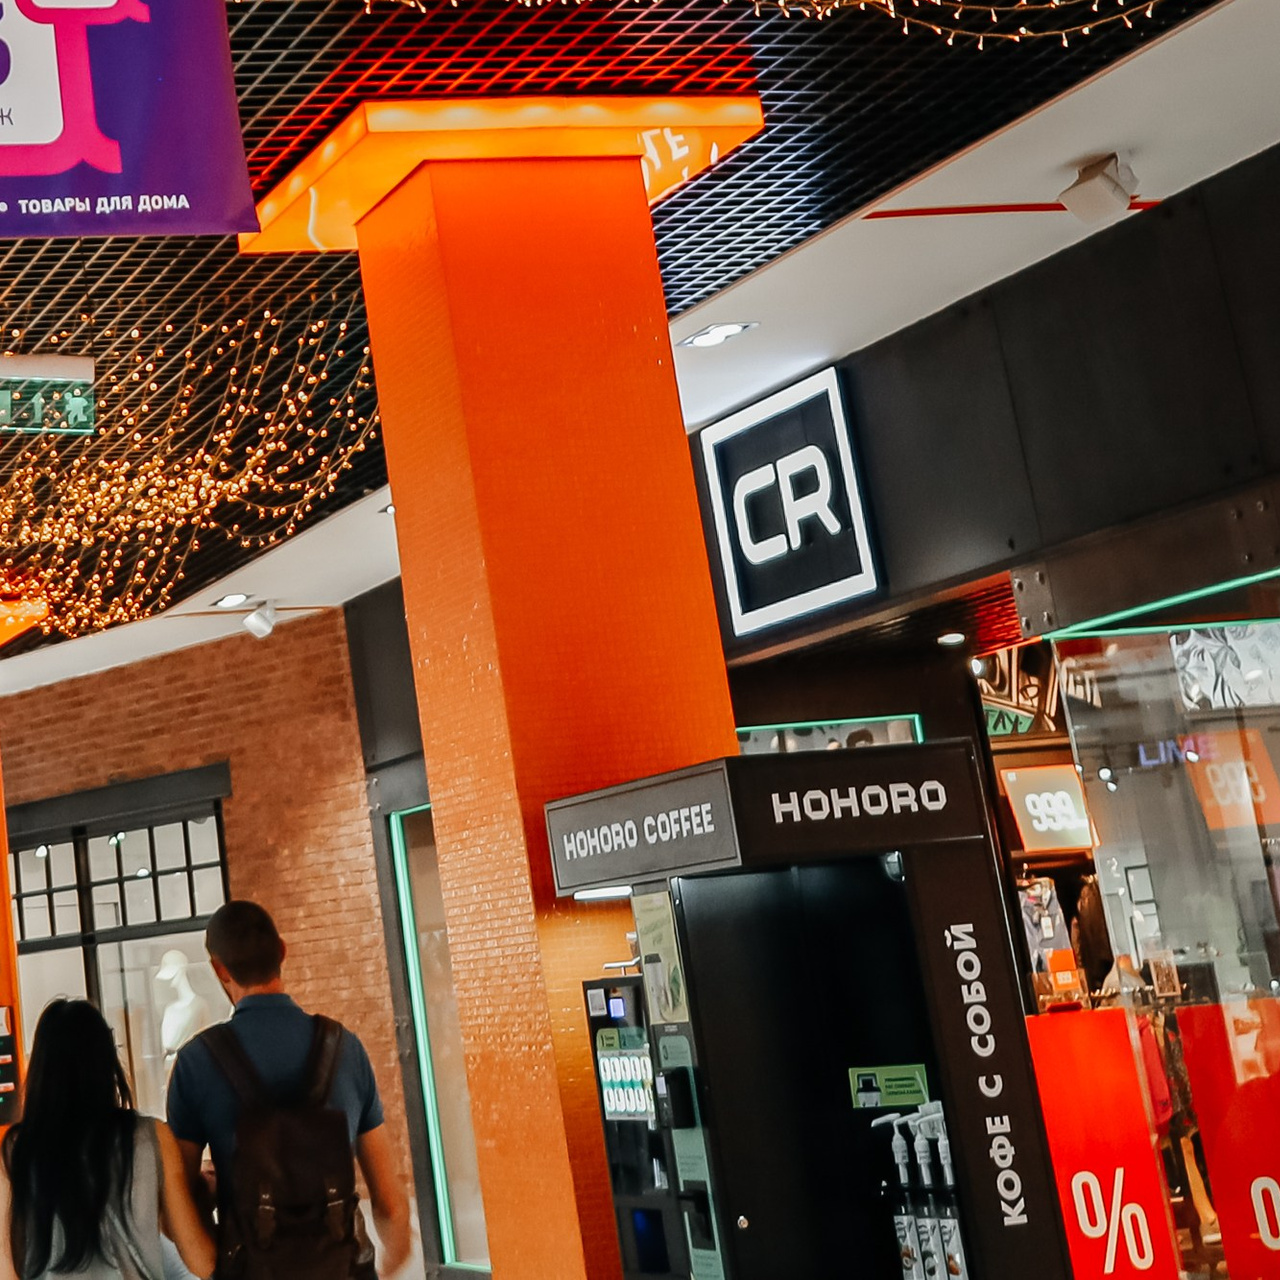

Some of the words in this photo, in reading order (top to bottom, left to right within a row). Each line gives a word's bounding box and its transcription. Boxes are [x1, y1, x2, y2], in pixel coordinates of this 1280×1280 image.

[18, 196, 90, 214] ТОВАРЫ
[95, 195, 133, 215] ДЛЯ
[137, 193, 190, 213] ДОМА
[733, 444, 842, 565] CR
[771, 779, 947, 824] HOHORO
[563, 819, 637, 861] HOHORO
[643, 802, 715, 844] COFFEE
[945, 922, 996, 1058] СОБОЙ
[978, 1074, 1003, 1098] С
[985, 1115, 1028, 1227] КОФЕ
